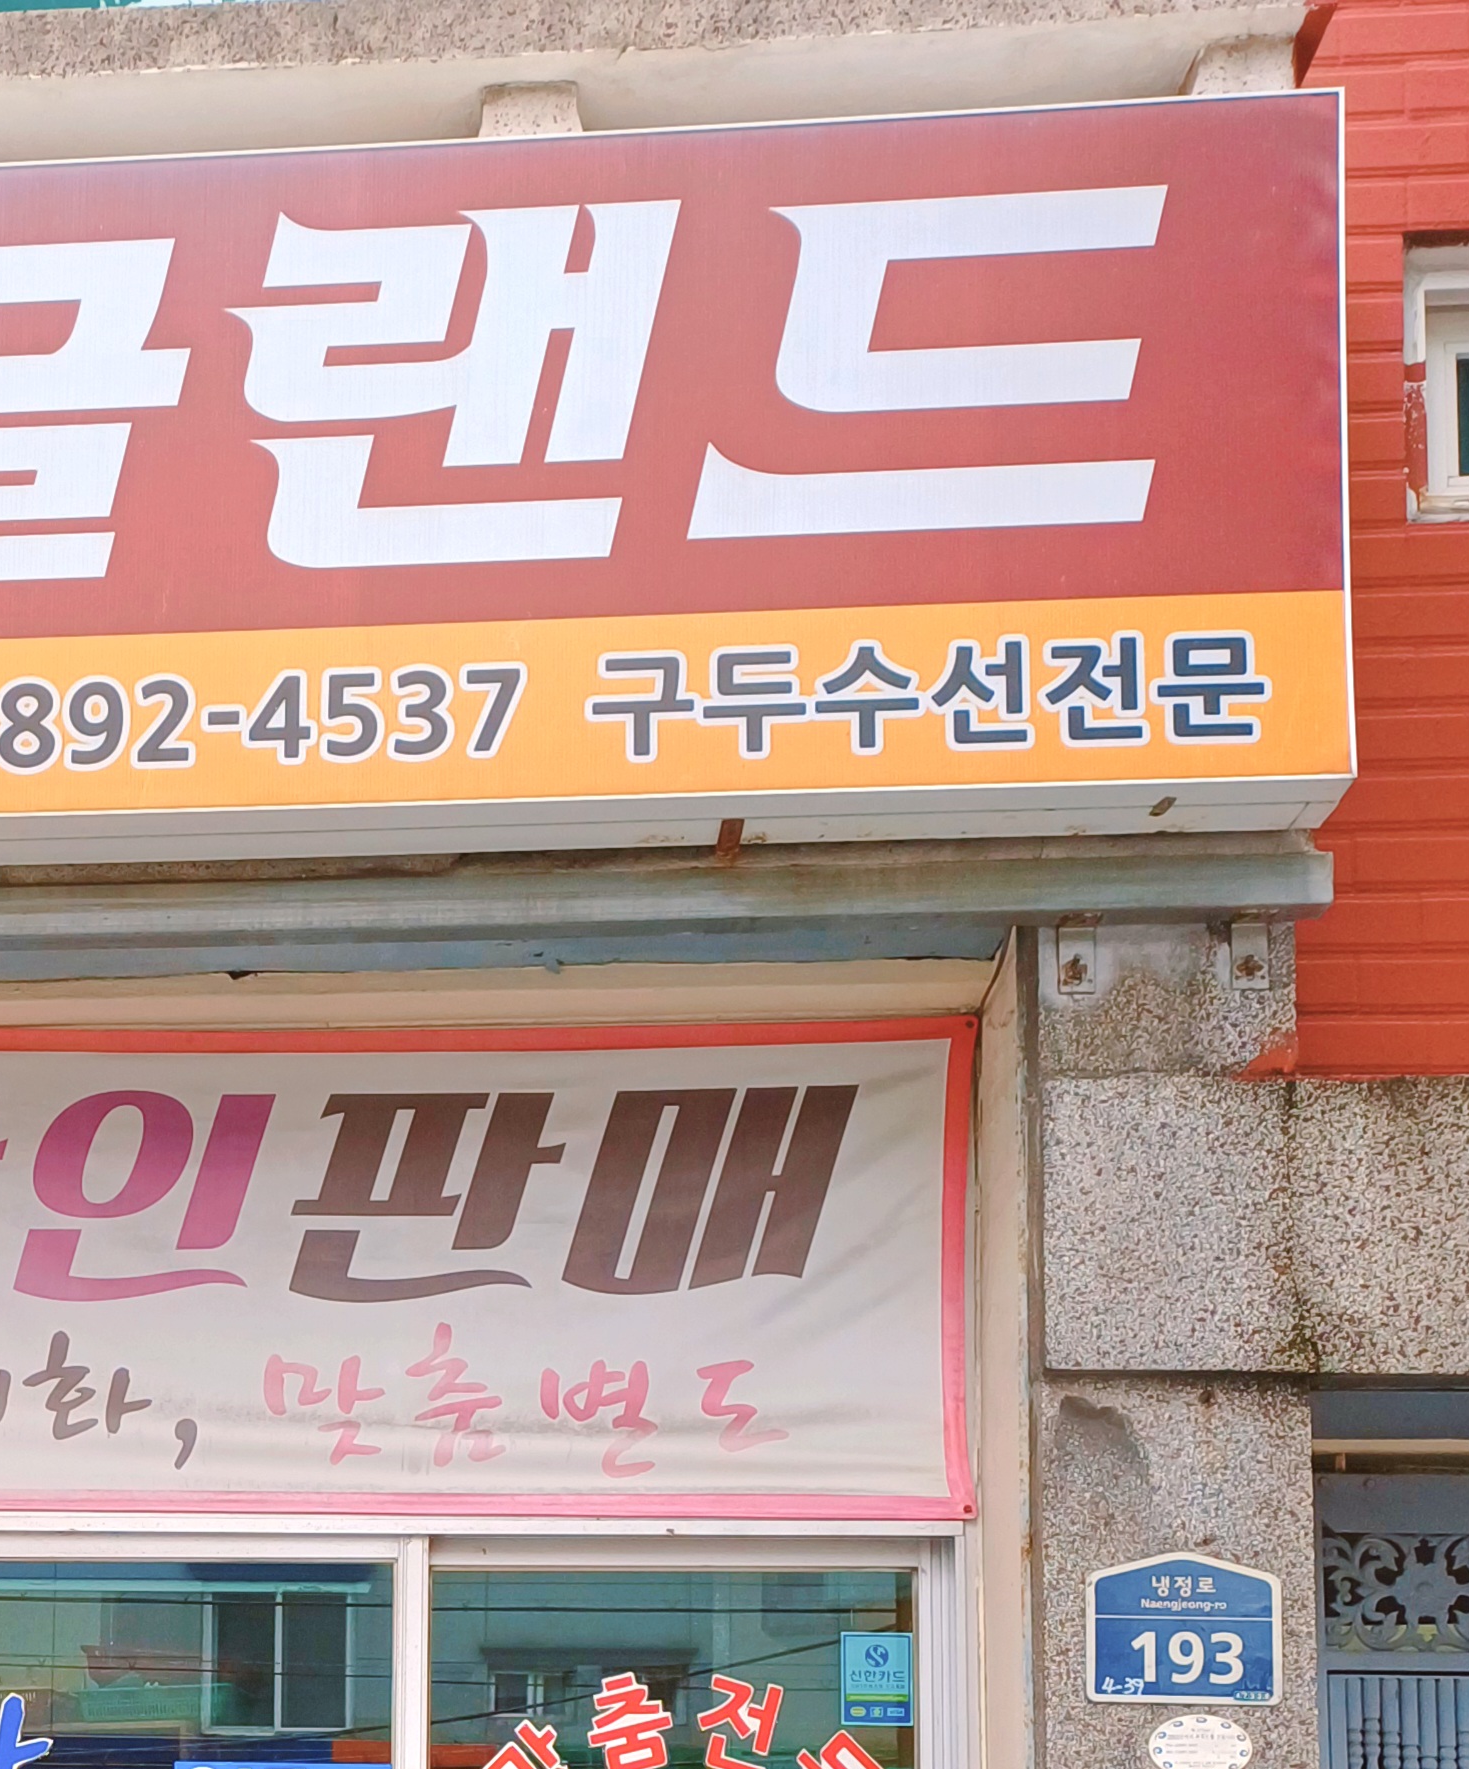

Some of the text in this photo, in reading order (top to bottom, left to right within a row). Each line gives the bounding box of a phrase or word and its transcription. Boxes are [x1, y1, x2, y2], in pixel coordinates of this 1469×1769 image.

[587, 632, 1269, 760] 구두수선전문
[1151, 1575, 1217, 1598] 냉정로
[1140, 1598, 1228, 1612] Naengjeong-ro
[1130, 1631, 1245, 1685] 193
[849, 1670, 905, 1683] 신한카드
